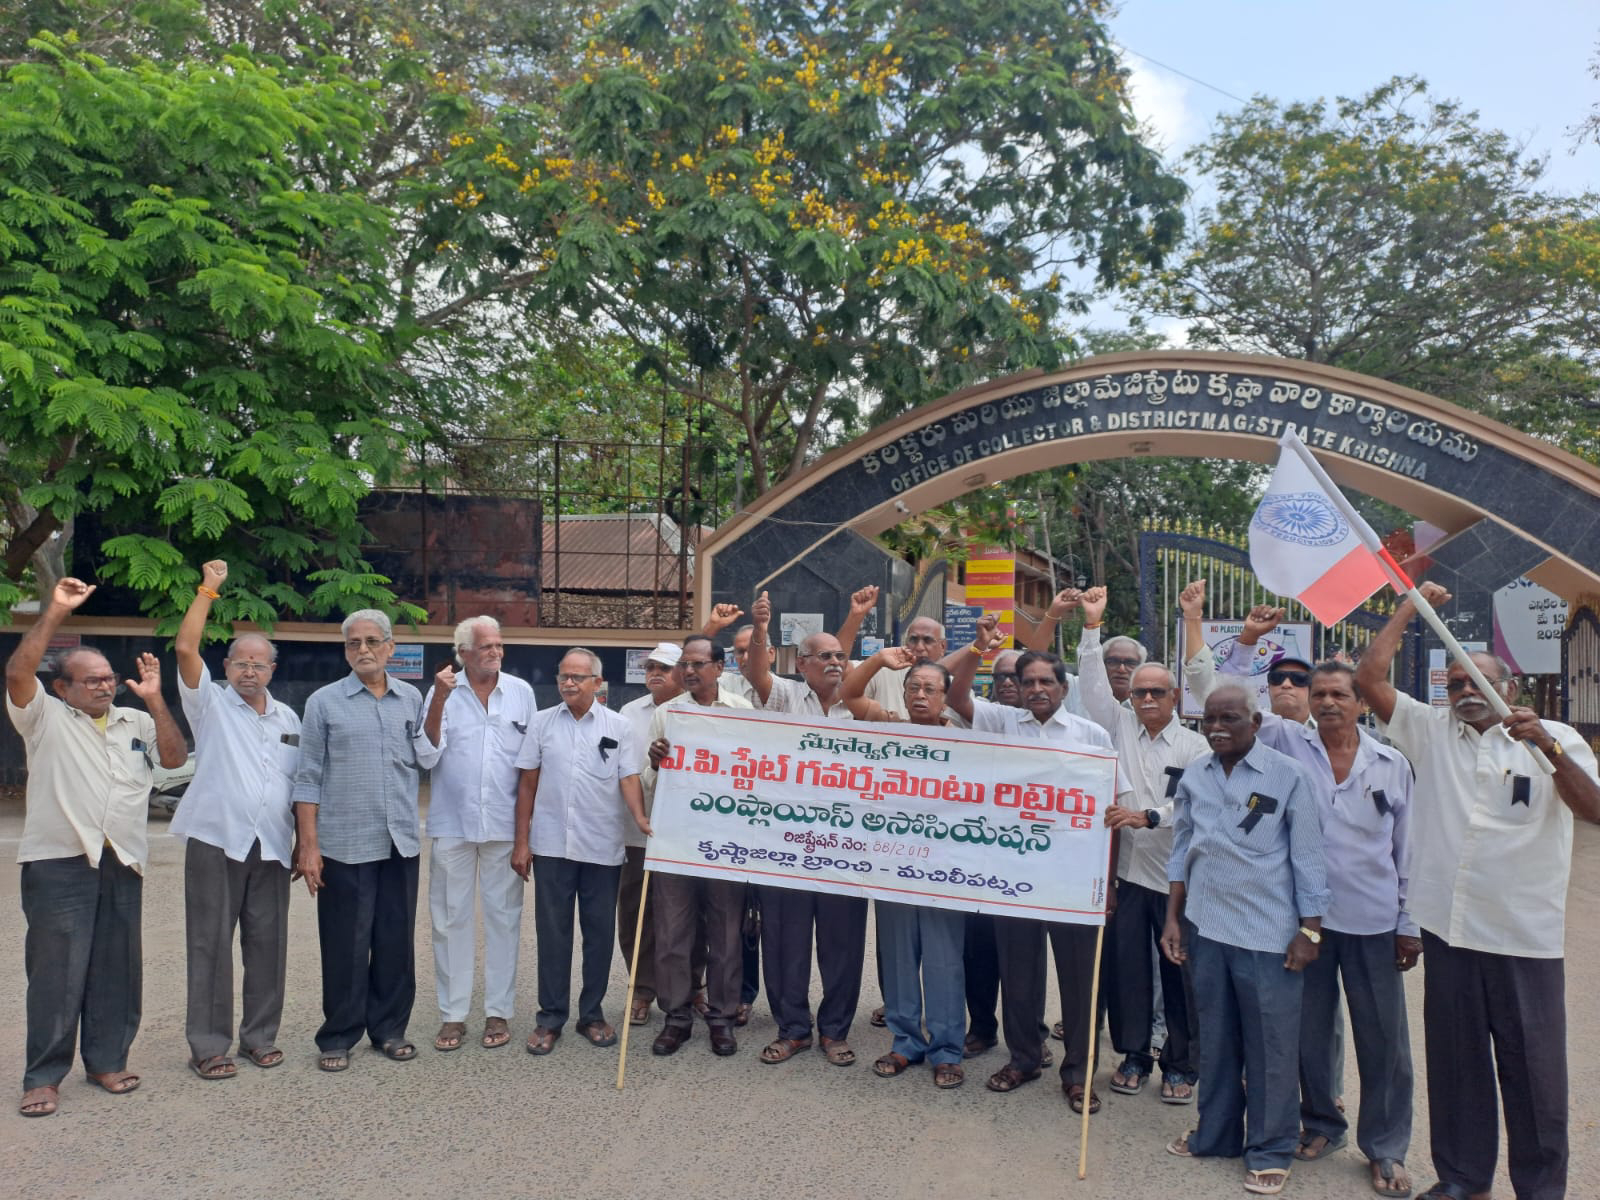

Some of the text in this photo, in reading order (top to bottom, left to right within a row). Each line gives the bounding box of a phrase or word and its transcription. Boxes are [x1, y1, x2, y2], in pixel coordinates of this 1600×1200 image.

[1269, 381, 1322, 410] వారి
[1327, 392, 1479, 463] కార్యాలయము
[891, 454, 951, 493] OFFICE
[953, 444, 976, 465] OF
[979, 417, 1084, 456] COLLECTOR
[1090, 415, 1103, 431] &
[1338, 435, 1428, 481] KRISHNA
[1210, 625, 1218, 633] NO
[1537, 629, 1562, 640] 202
[799, 732, 951, 762] సుస్వాగతం
[993, 782, 1097, 830] రిటైర్డు
[861, 811, 1052, 856] అసోసియేషన్
[897, 864, 1033, 898] మచిలీపట్నం
